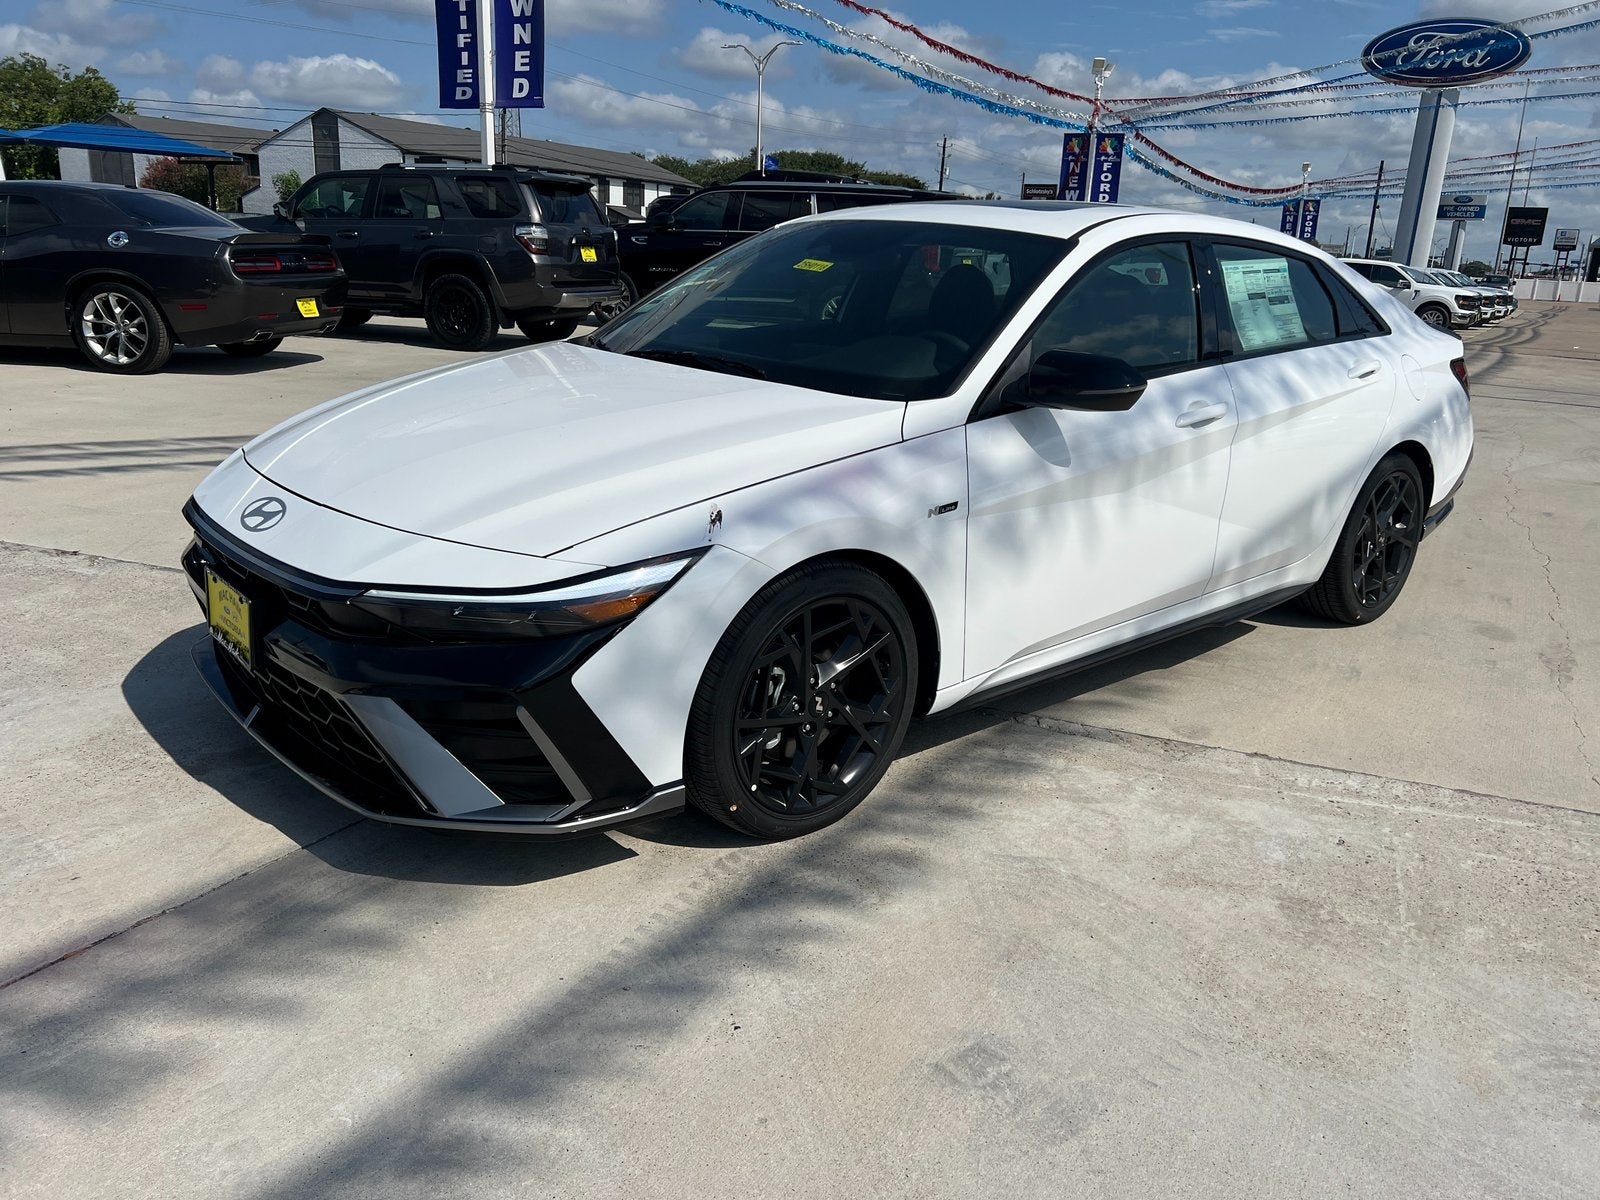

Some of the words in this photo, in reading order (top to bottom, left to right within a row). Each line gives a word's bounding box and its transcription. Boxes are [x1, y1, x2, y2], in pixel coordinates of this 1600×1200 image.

[1395, 32, 1496, 69] Ford
[1098, 162, 1113, 203] FORD
[1303, 215, 1313, 238] FORD
[1510, 218, 1542, 226] GMC
